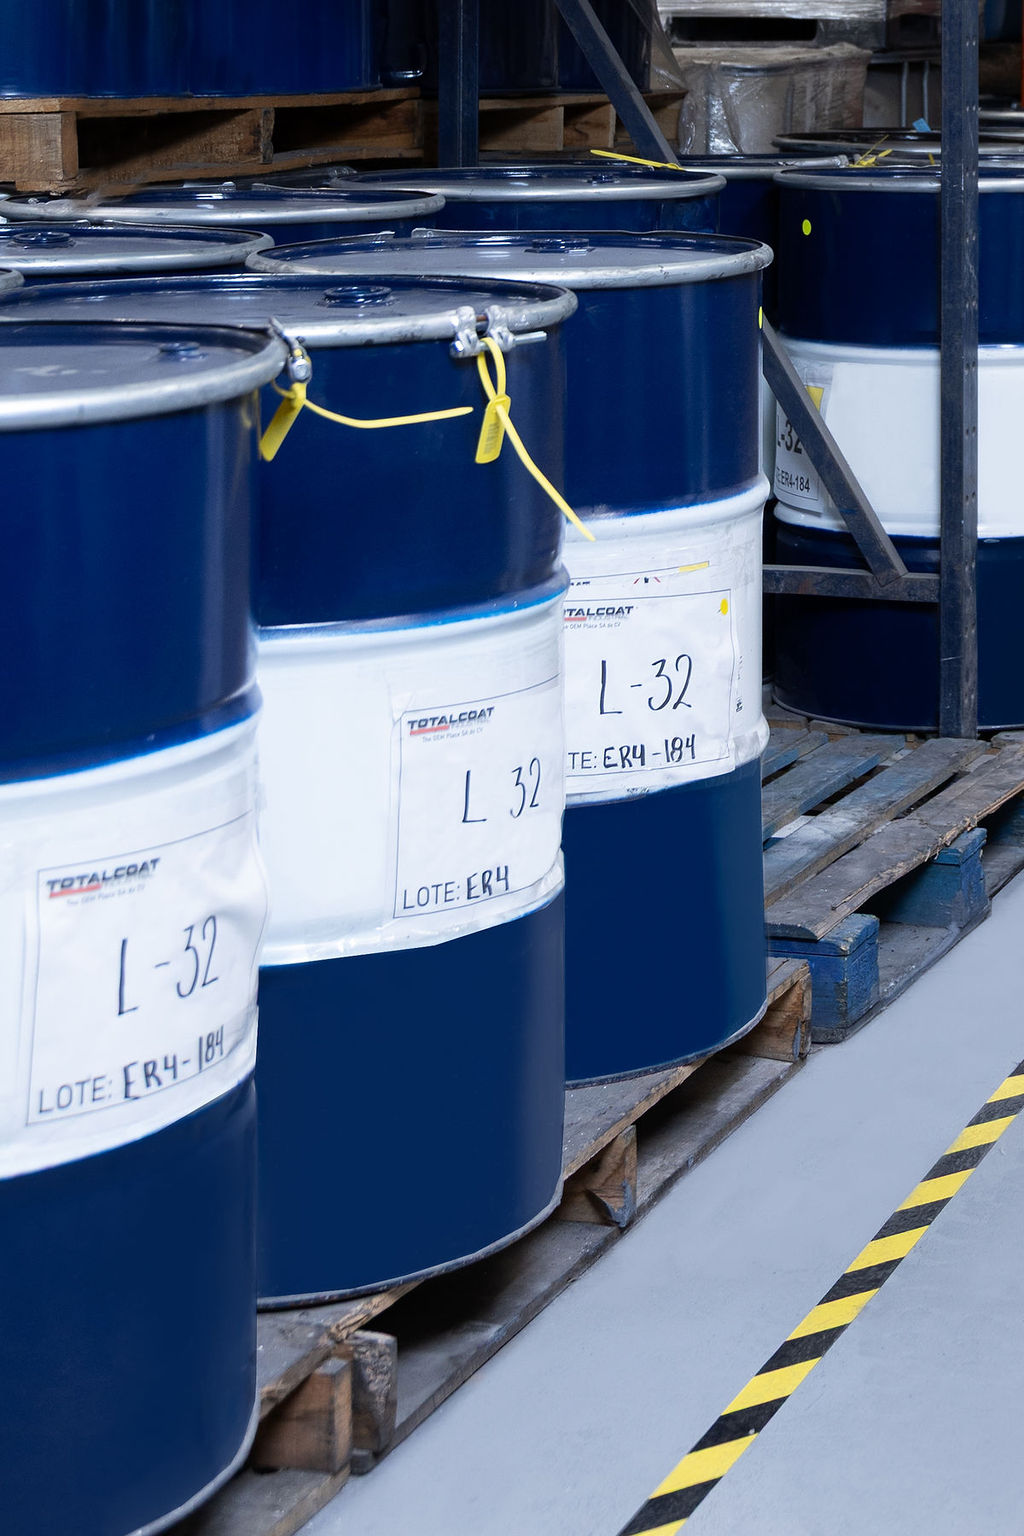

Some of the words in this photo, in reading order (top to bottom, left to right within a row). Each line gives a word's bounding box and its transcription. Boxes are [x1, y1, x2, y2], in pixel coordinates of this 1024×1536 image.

[563, 605, 634, 617] TALCOAT
[407, 706, 495, 731] TOTALCOAT
[603, 734, 696, 769] ER4-184
[46, 856, 161, 892] TOTALCOAT
[403, 880, 461, 910] LOTE:
[466, 865, 510, 901] ER4
[39, 1075, 112, 1115] LOTE:
[123, 1025, 224, 1100] ER4-184
